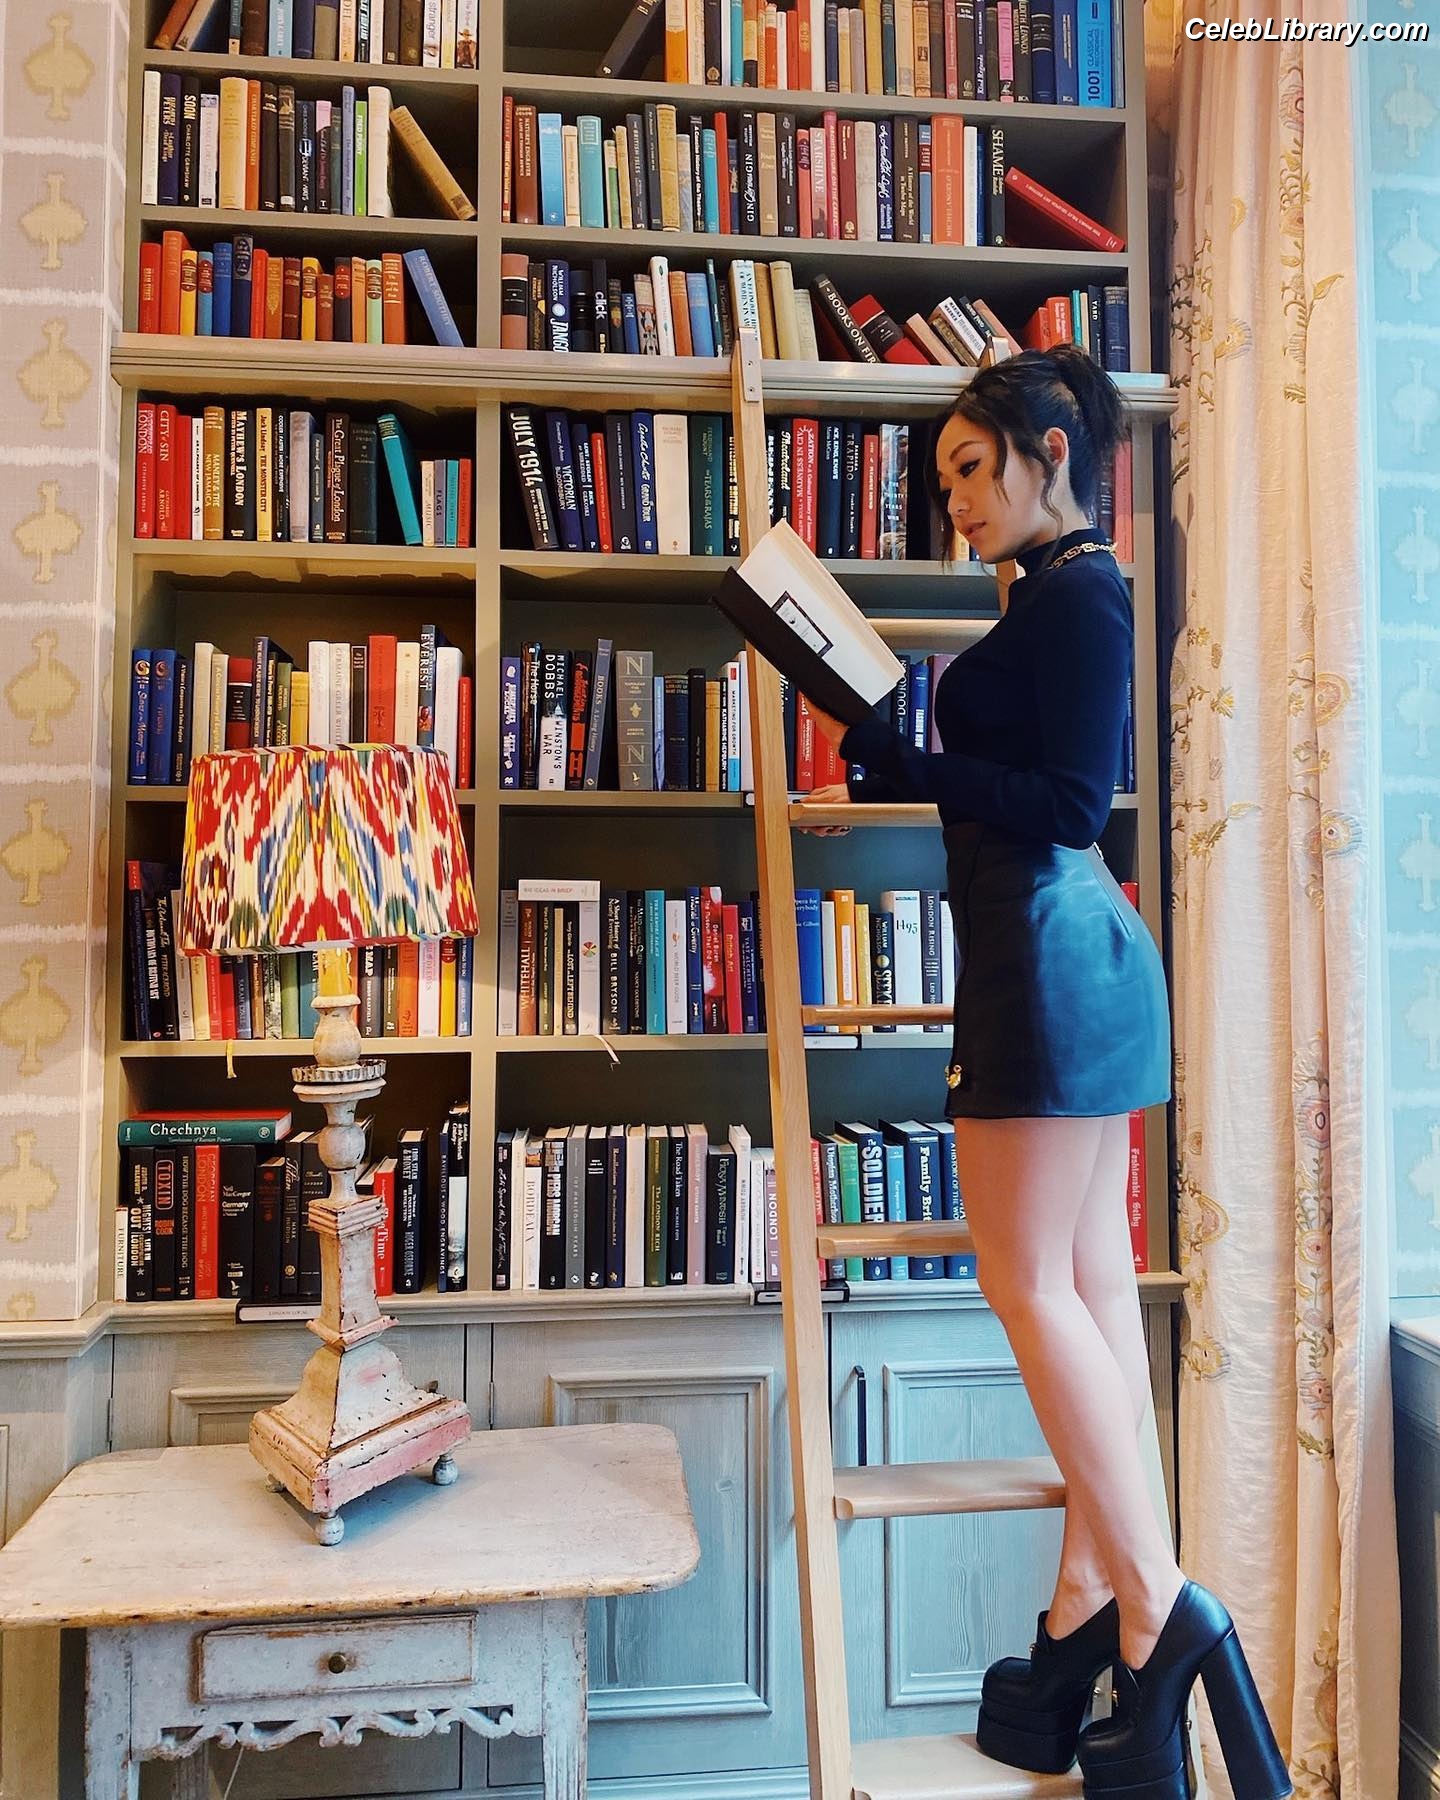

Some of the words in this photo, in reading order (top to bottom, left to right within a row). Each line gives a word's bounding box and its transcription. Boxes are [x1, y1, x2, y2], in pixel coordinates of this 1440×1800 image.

[426, 2, 436, 40] stranger
[1019, 25, 1028, 55] LENNOX
[1088, 70, 1099, 101] 1001
[184, 95, 196, 119] SOON
[745, 154, 753, 173] GIN
[813, 132, 825, 193] STARSHINE
[992, 129, 1003, 176] SHAME
[746, 203, 754, 222] GIN
[419, 255, 436, 287] ROBERT
[595, 291, 607, 320] click
[828, 291, 851, 328] BOOKS
[847, 325, 865, 345] ON
[550, 318, 569, 353] JANGO
[138, 409, 147, 454] LONDON
[160, 410, 169, 436] CITY
[236, 411, 247, 463] MAYHEW'S
[510, 412, 536, 447] JULY
[160, 443, 169, 461] SIN
[334, 429, 345, 453] Great
[846, 433, 854, 480] TRAPIDO
[331, 455, 345, 483] Plague
[518, 450, 543, 487] 1914
[781, 431, 791, 490] Theatreland
[235, 466, 247, 506] LONDON
[555, 466, 565, 510] BLOOMSBURY
[562, 465, 576, 511] VICTORIAN
[334, 490, 345, 522] London
[704, 506, 712, 529] RAJAS
[420, 633, 429, 690] EVEREST
[532, 661, 540, 677] The
[544, 654, 555, 699] DOBBS
[556, 655, 565, 699] MICHAEL
[626, 657, 643, 675] N
[530, 678, 539, 705] Horse
[595, 675, 605, 705] BOOKS
[543, 734, 552, 755] WAR
[554, 721, 562, 769] WINSTON'S
[627, 745, 645, 763] N
[365, 951, 373, 977] MAP
[610, 953, 618, 971] BILL
[520, 947, 530, 1010] WHITEHALL
[610, 976, 618, 1013] BRYSON
[874, 969, 892, 1005] SEEK
[150, 1123, 217, 1136] Chechnya
[197, 1153, 207, 1202] LONDON
[402, 1156, 411, 1180] MONEY
[826, 1147, 836, 1179] Utopian
[920, 1146, 931, 1193] Family
[158, 1164, 171, 1205] TOXIN
[547, 1174, 561, 1197] PIERS
[142, 1204, 151, 1231] NIGHTS
[525, 1181, 536, 1243] BORDEAUX
[546, 1199, 560, 1236] MORGAN
[768, 1193, 778, 1240] LONDON
[829, 1180, 839, 1223] Motherhoo
[922, 1196, 933, 1221] Brit
[1131, 1202, 1140, 1227] Selby
[131, 1208, 141, 1229] OUT
[131, 1235, 139, 1266] LONDON
[377, 1228, 388, 1260] Time
